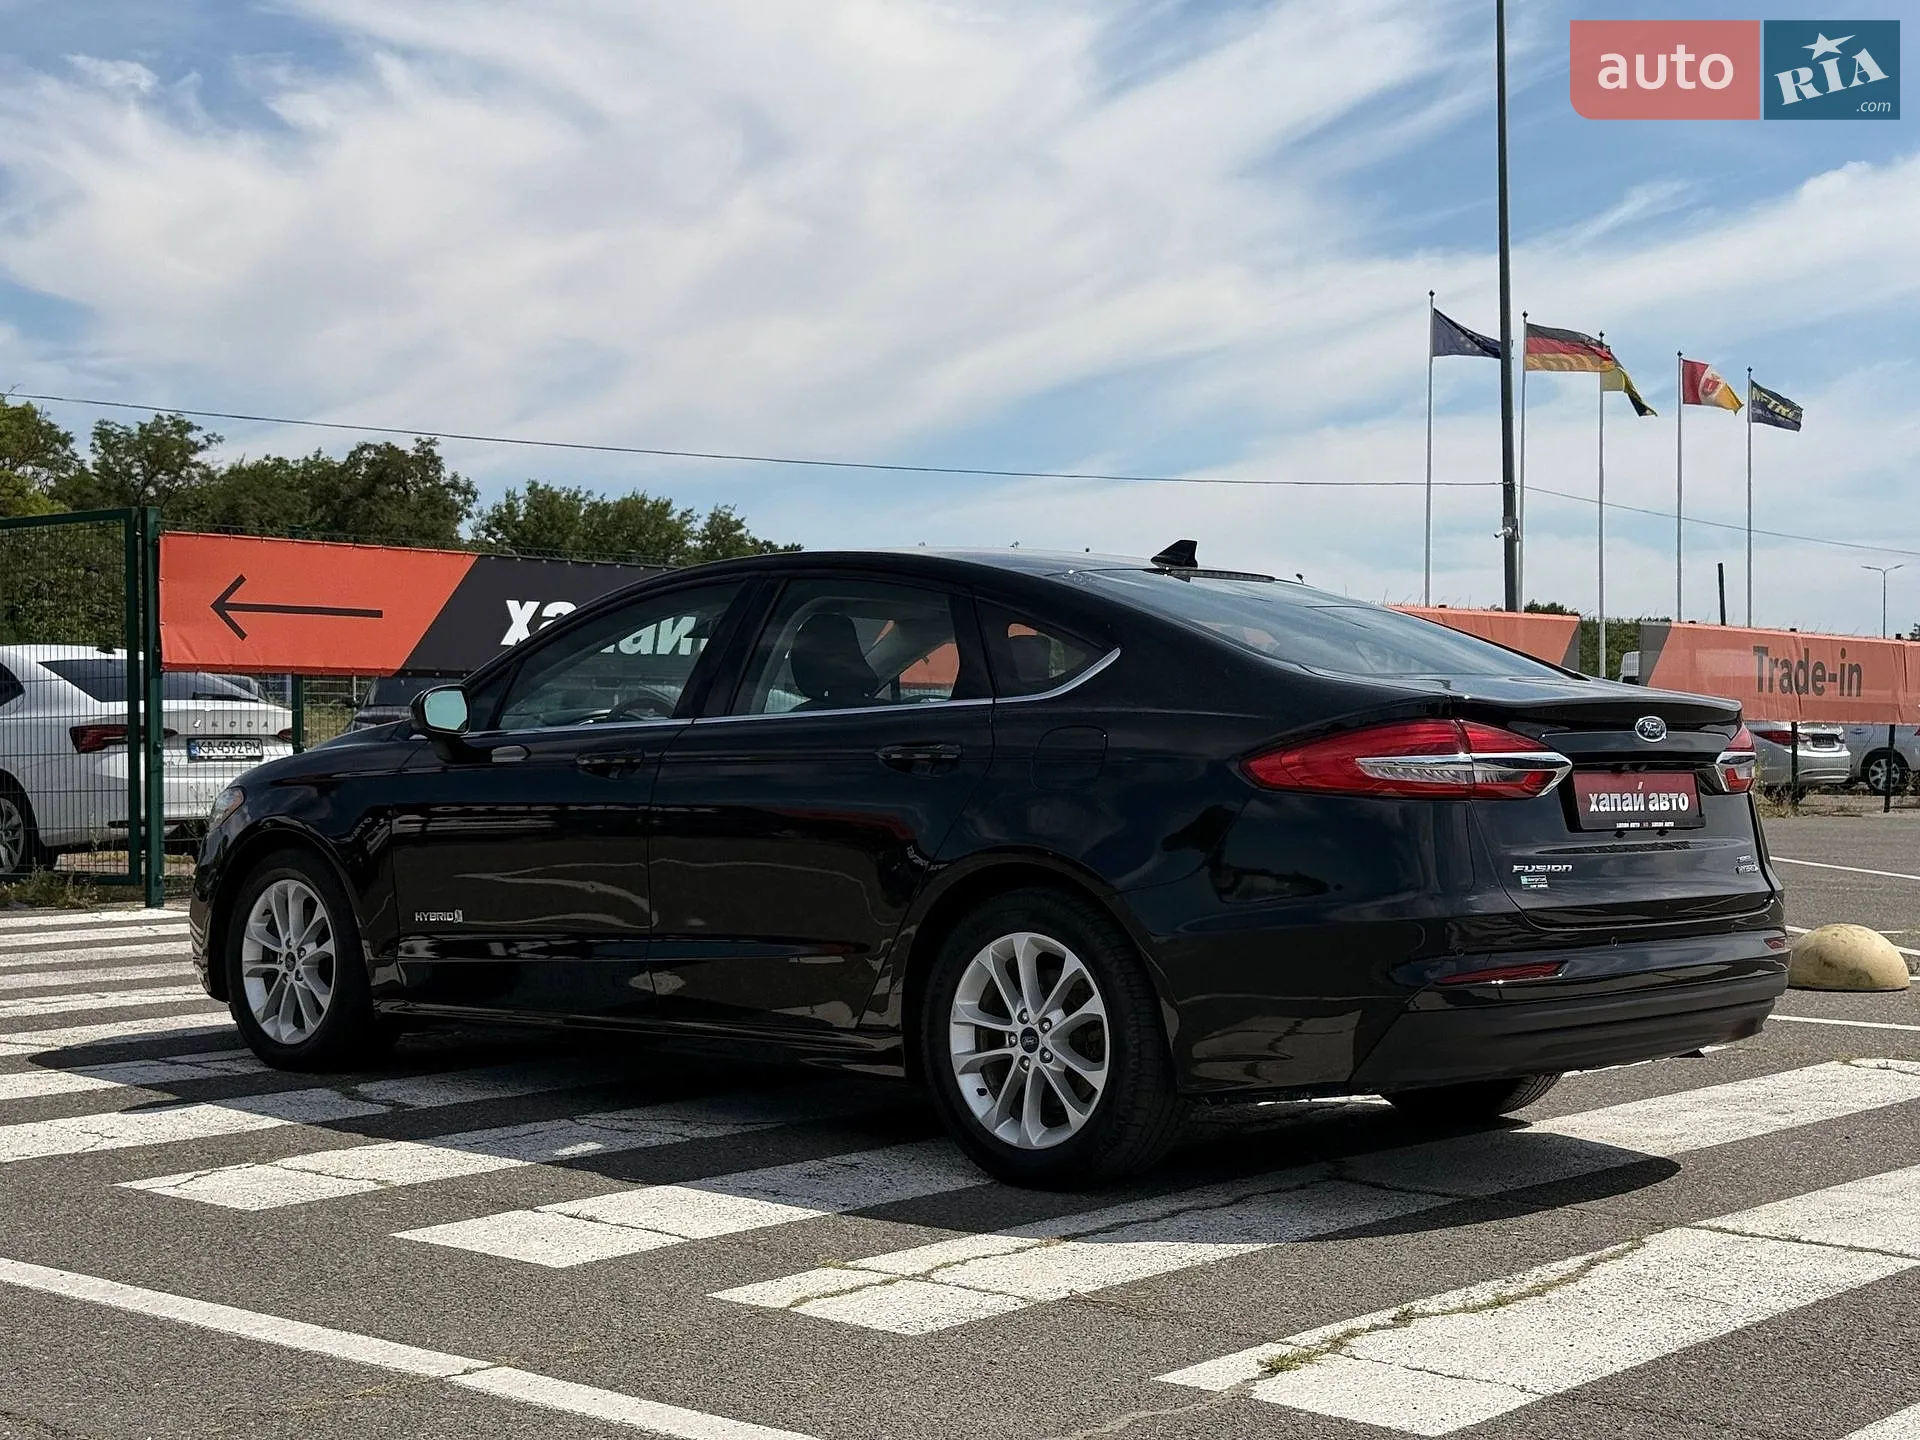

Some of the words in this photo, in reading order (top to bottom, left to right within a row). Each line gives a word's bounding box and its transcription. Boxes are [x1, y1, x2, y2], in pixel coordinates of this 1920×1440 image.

[1752, 645, 1863, 697] Trade-in
[1648, 792, 1689, 812] авто
[1512, 864, 1573, 873] FUSION
[415, 911, 454, 922] HYBRID
